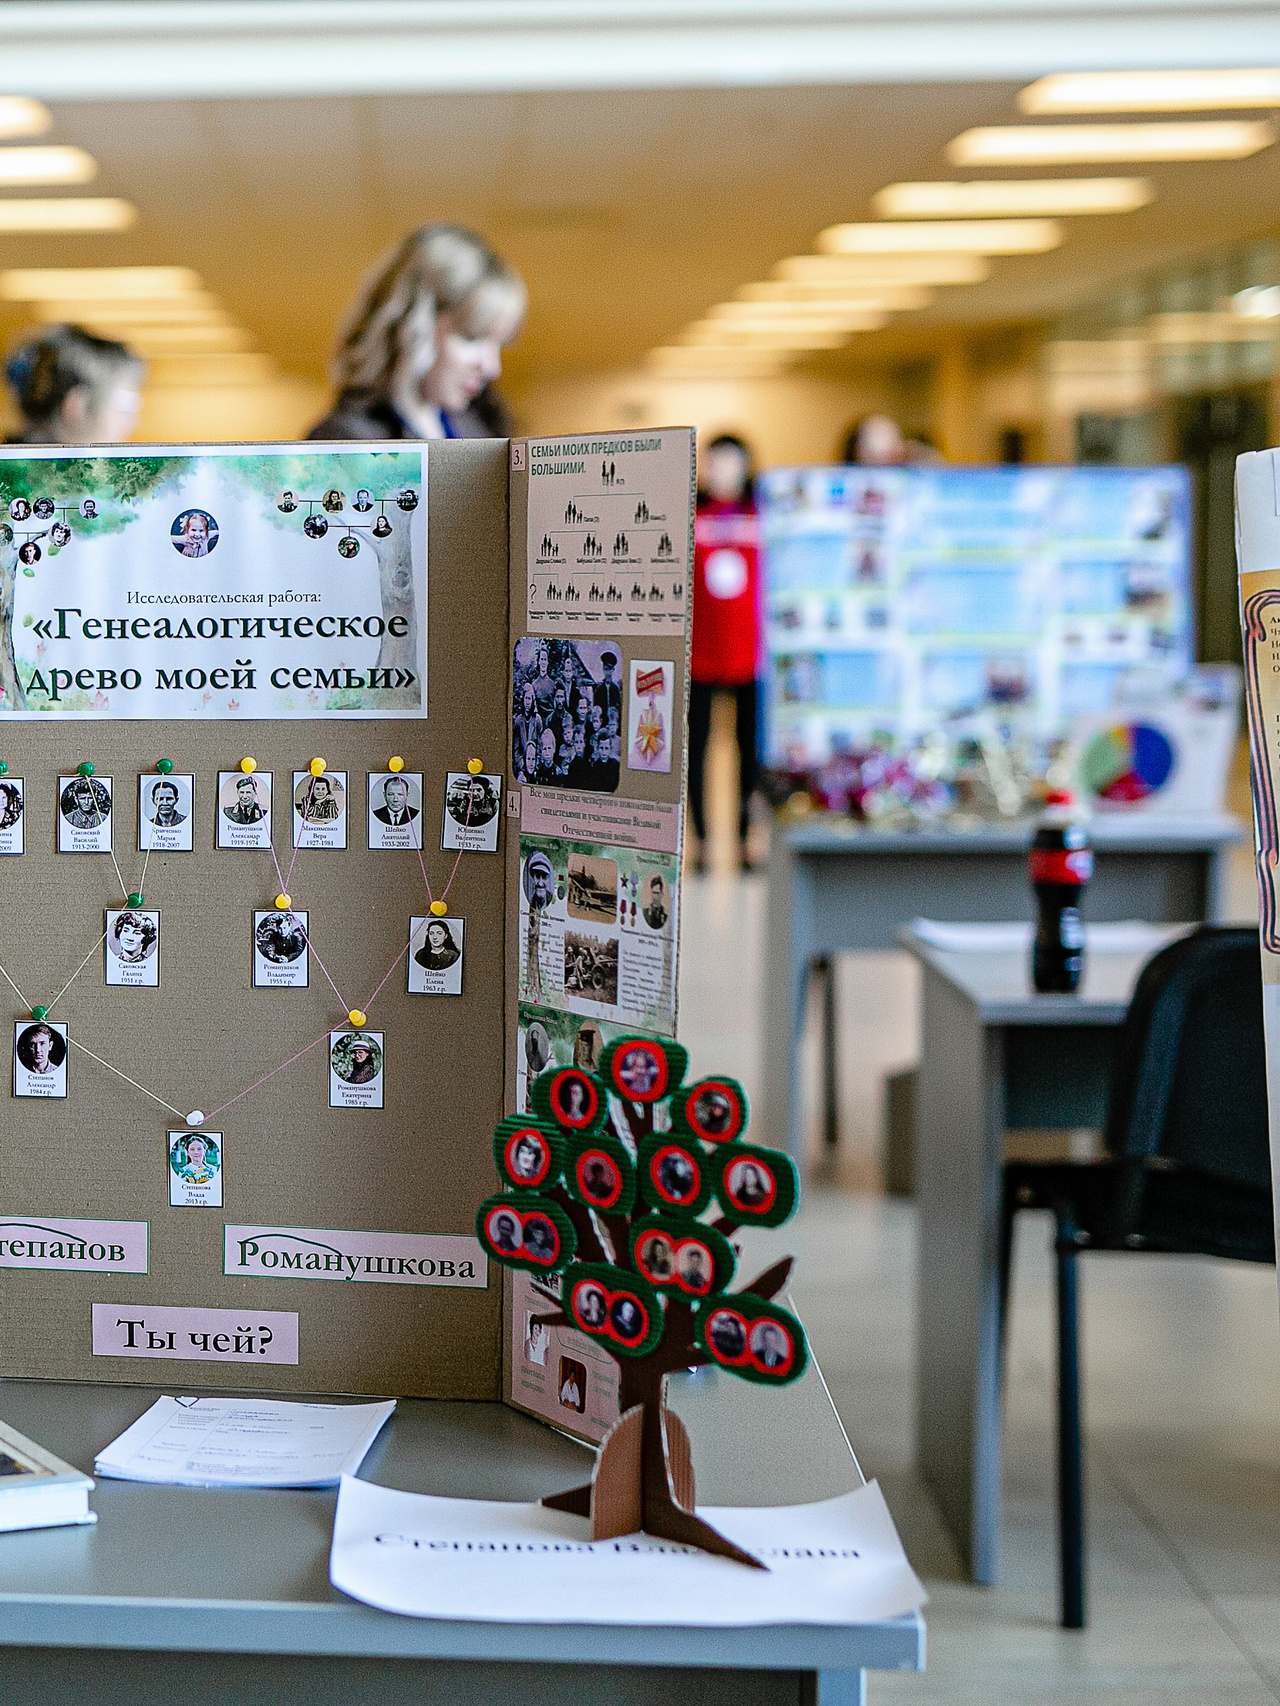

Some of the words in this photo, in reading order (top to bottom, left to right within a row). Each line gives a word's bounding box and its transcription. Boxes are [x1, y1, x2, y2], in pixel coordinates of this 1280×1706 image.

[531, 445, 562, 458] СЕМЬИ
[562, 443, 590, 456] МОИХ
[592, 440, 633, 456] ПРЕДКОВ
[635, 438, 662, 451] БЫЛИ
[513, 449, 523, 465] 3.
[531, 461, 587, 476] БОЛЬШИМИ.
[126, 591, 264, 604] Исследовательская
[268, 590, 321, 607] работа:
[32, 607, 409, 640] «Генеалогическое
[26, 667, 141, 701] древо
[155, 659, 255, 690] моей
[270, 668, 416, 690] семьи»
[530, 787, 542, 797] Все
[509, 796, 517, 812] 4.
[267, 971, 296, 979] Владимир
[337, 1084, 376, 1092] Романушкова
[237, 1241, 475, 1281] Романушкова
[116, 1318, 176, 1351] Ты
[188, 1325, 273, 1356] чей?
